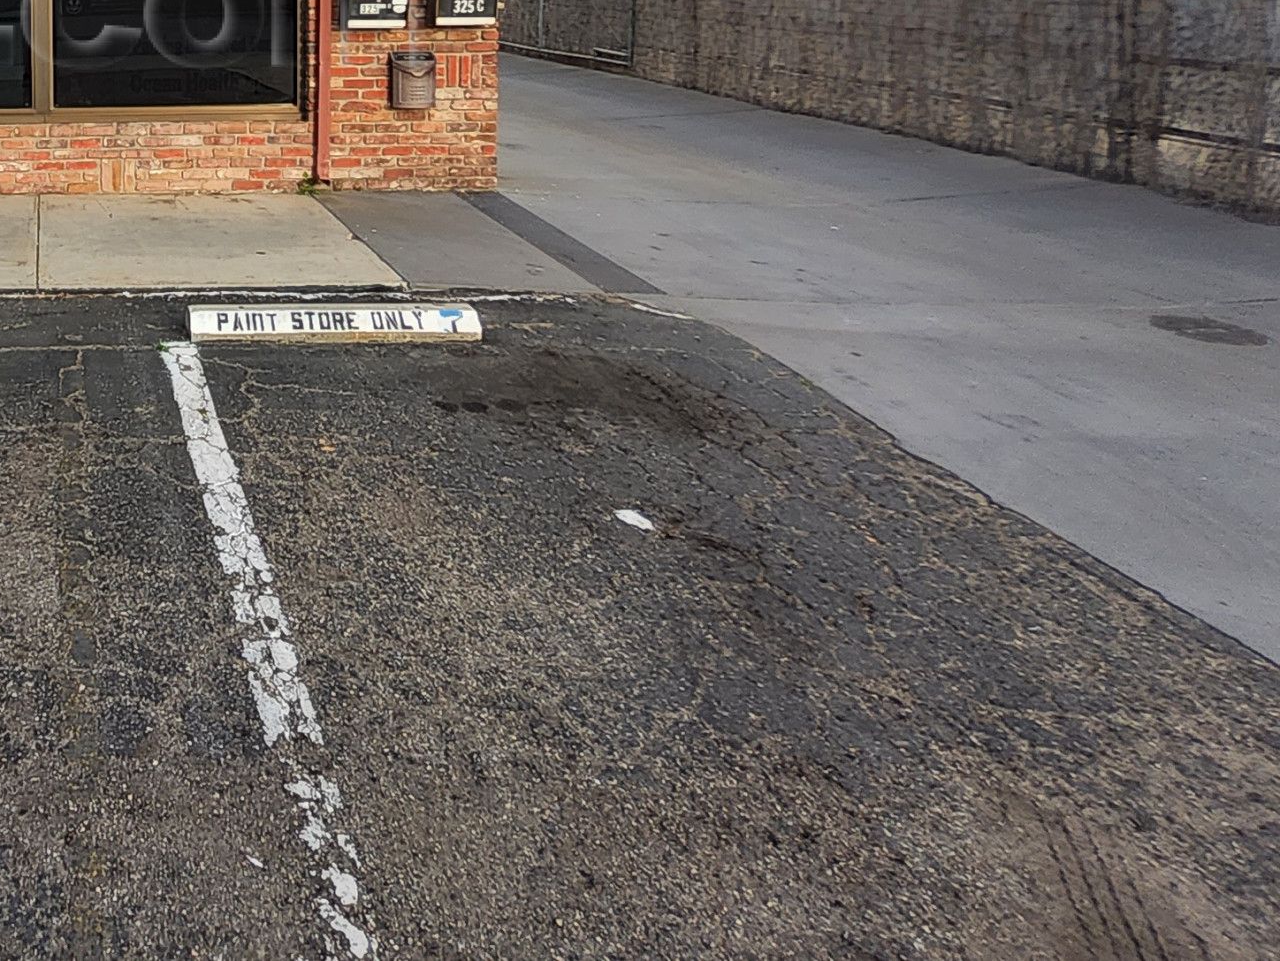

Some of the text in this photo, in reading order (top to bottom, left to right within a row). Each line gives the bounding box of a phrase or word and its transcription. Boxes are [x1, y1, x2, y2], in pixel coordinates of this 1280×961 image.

[452, 0, 475, 14] 325
[216, 310, 426, 332] PAINT STORE ONLY
